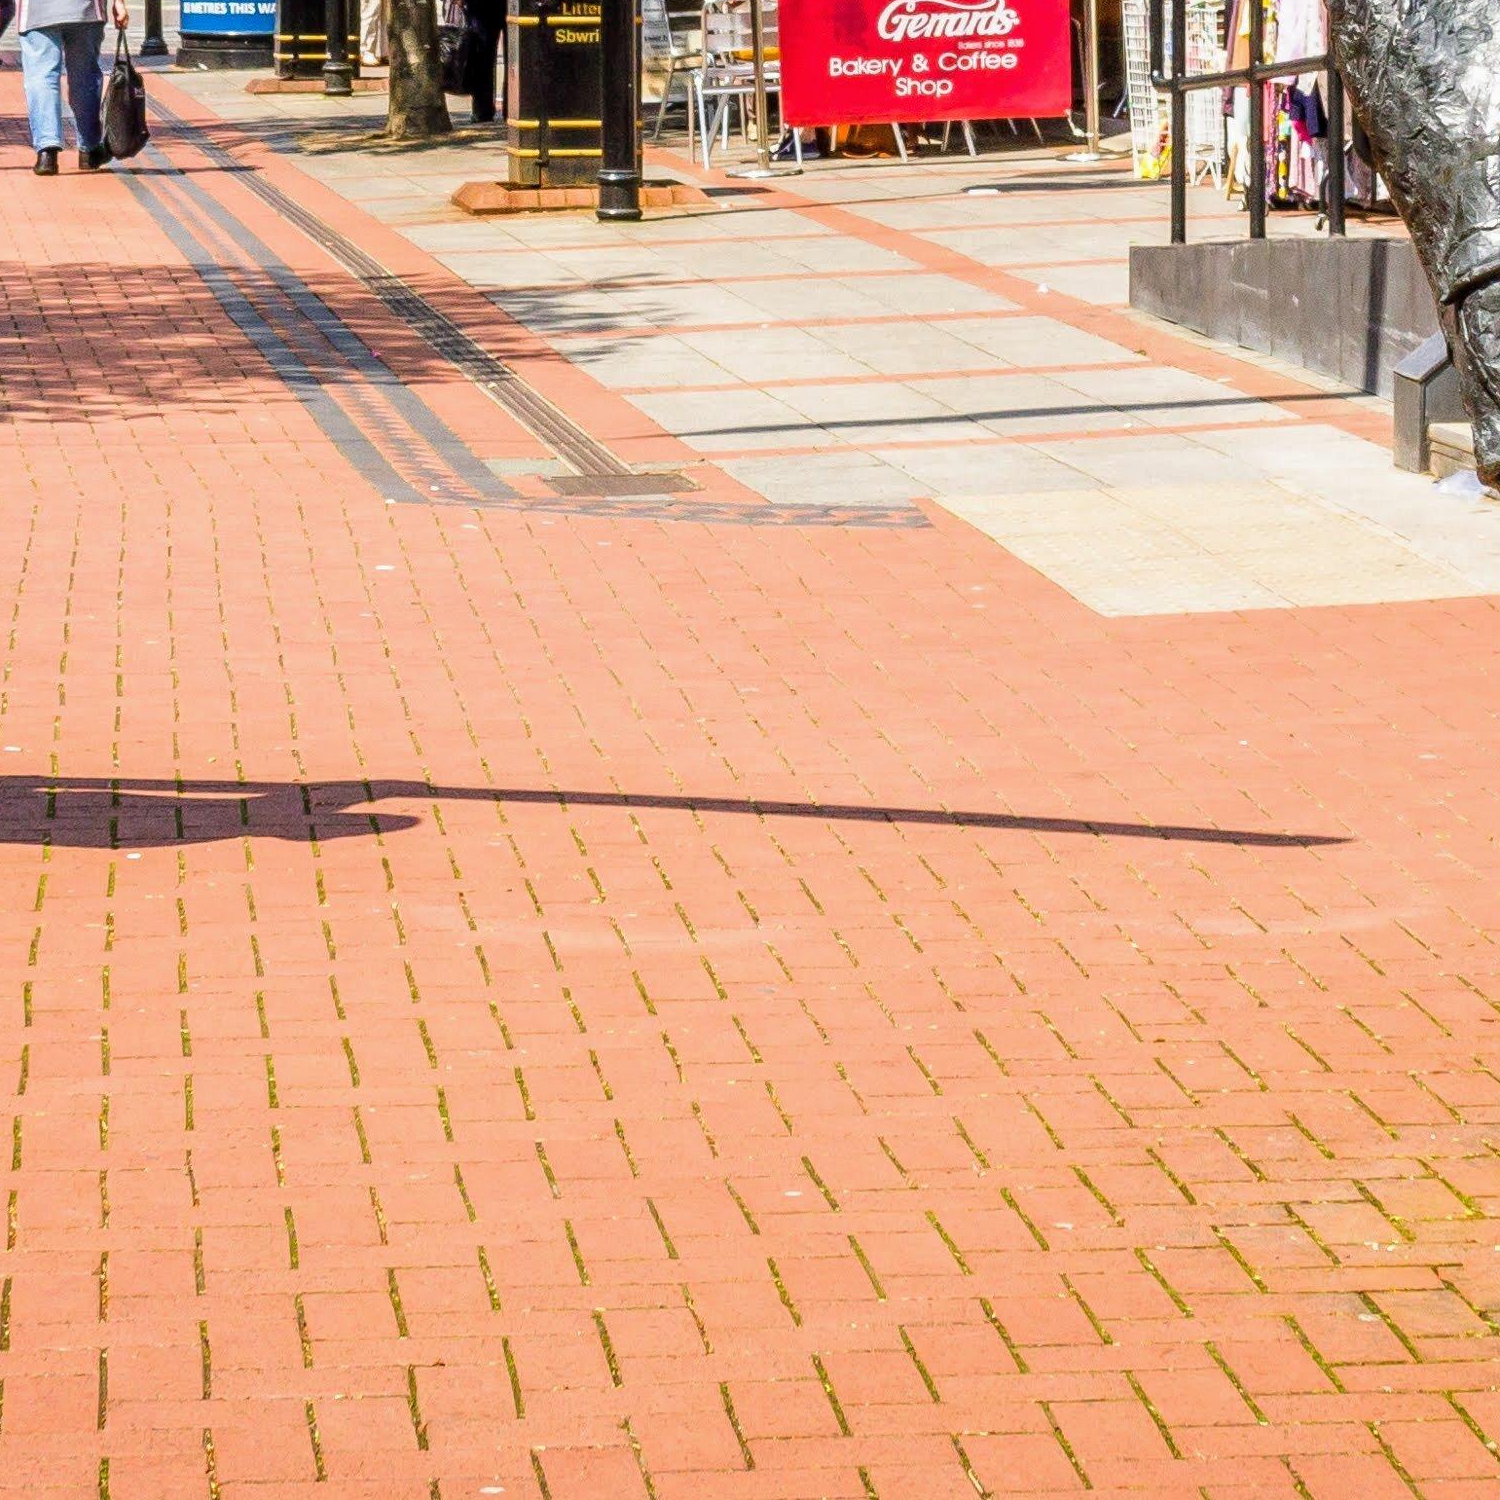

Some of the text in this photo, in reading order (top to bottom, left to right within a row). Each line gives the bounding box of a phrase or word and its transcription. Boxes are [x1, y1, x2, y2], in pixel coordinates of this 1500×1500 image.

[228, 2, 255, 15] THIS
[257, 2, 277, 15] WA
[556, 29, 600, 43] Sbwri
[829, 51, 1018, 77] Bakery & Coffee
[895, 76, 953, 98] Shop
